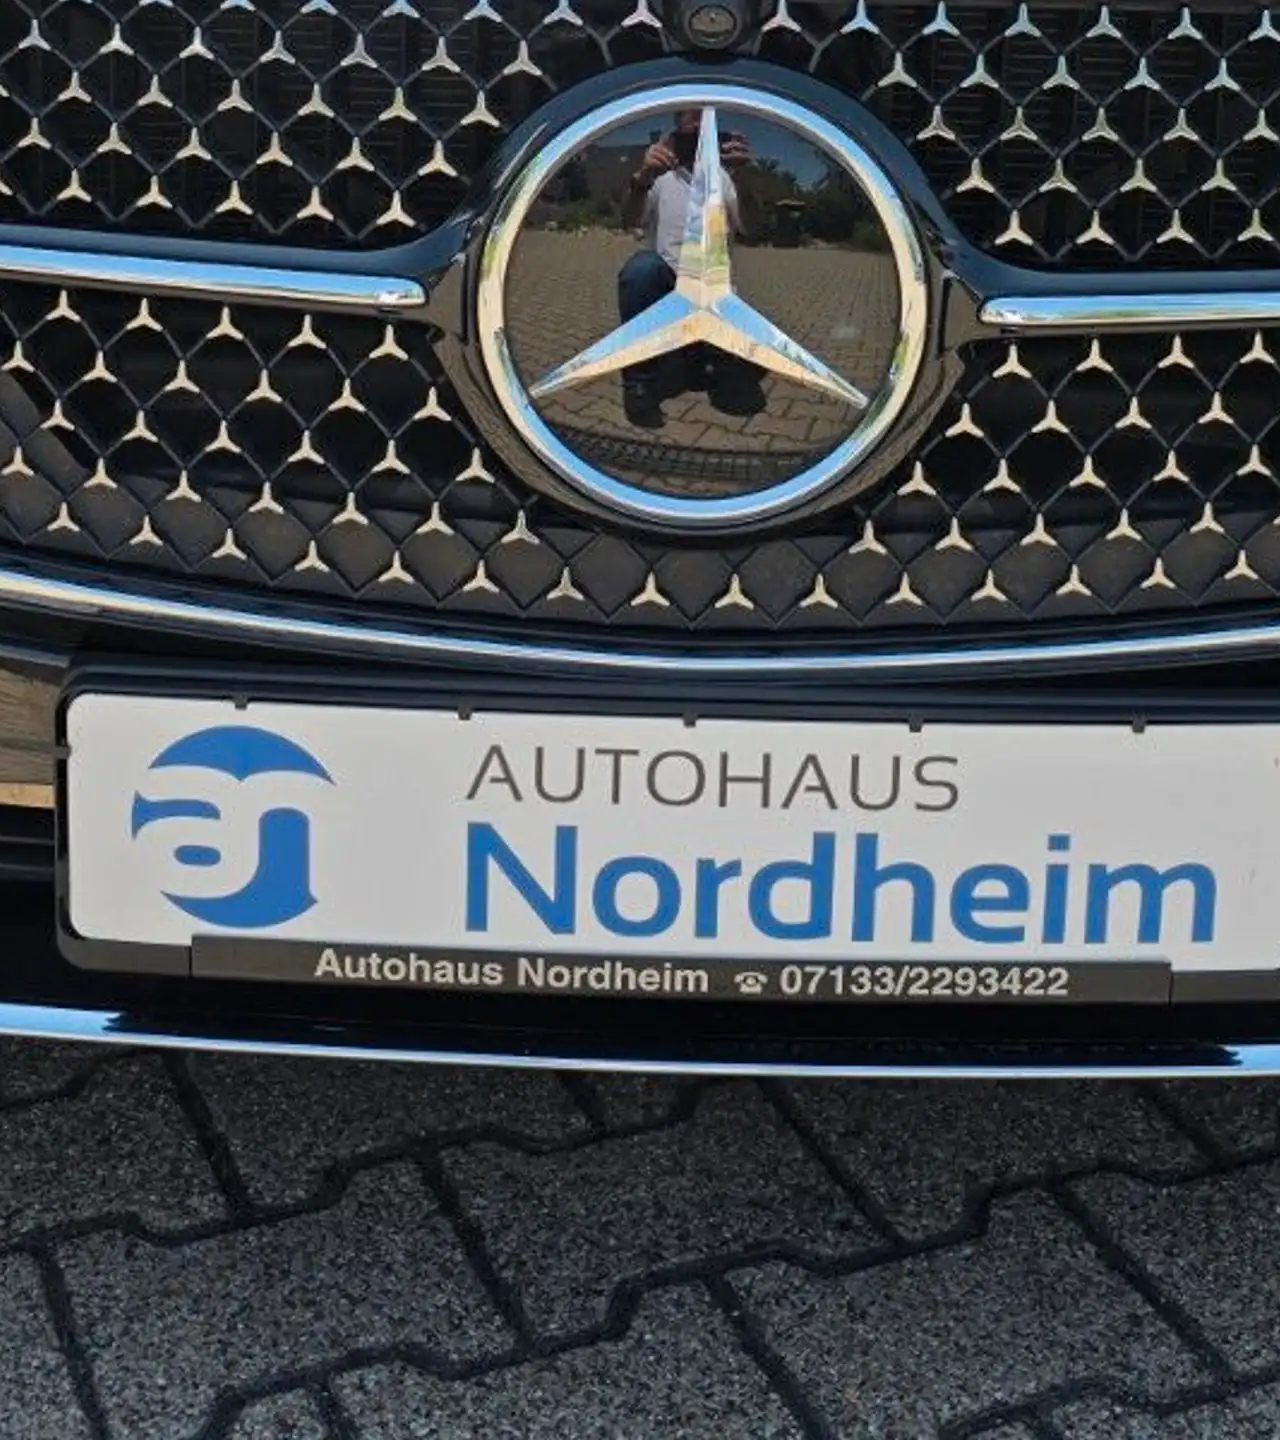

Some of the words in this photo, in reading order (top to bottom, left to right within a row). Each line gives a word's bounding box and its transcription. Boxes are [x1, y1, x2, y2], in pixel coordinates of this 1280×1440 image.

[466, 743, 961, 812] AUTOHAUS
[464, 819, 1219, 945] Nordheim
[314, 946, 504, 986] Autohaus
[516, 956, 709, 994] Nordheim
[780, 964, 1069, 996] 07133/2293422
